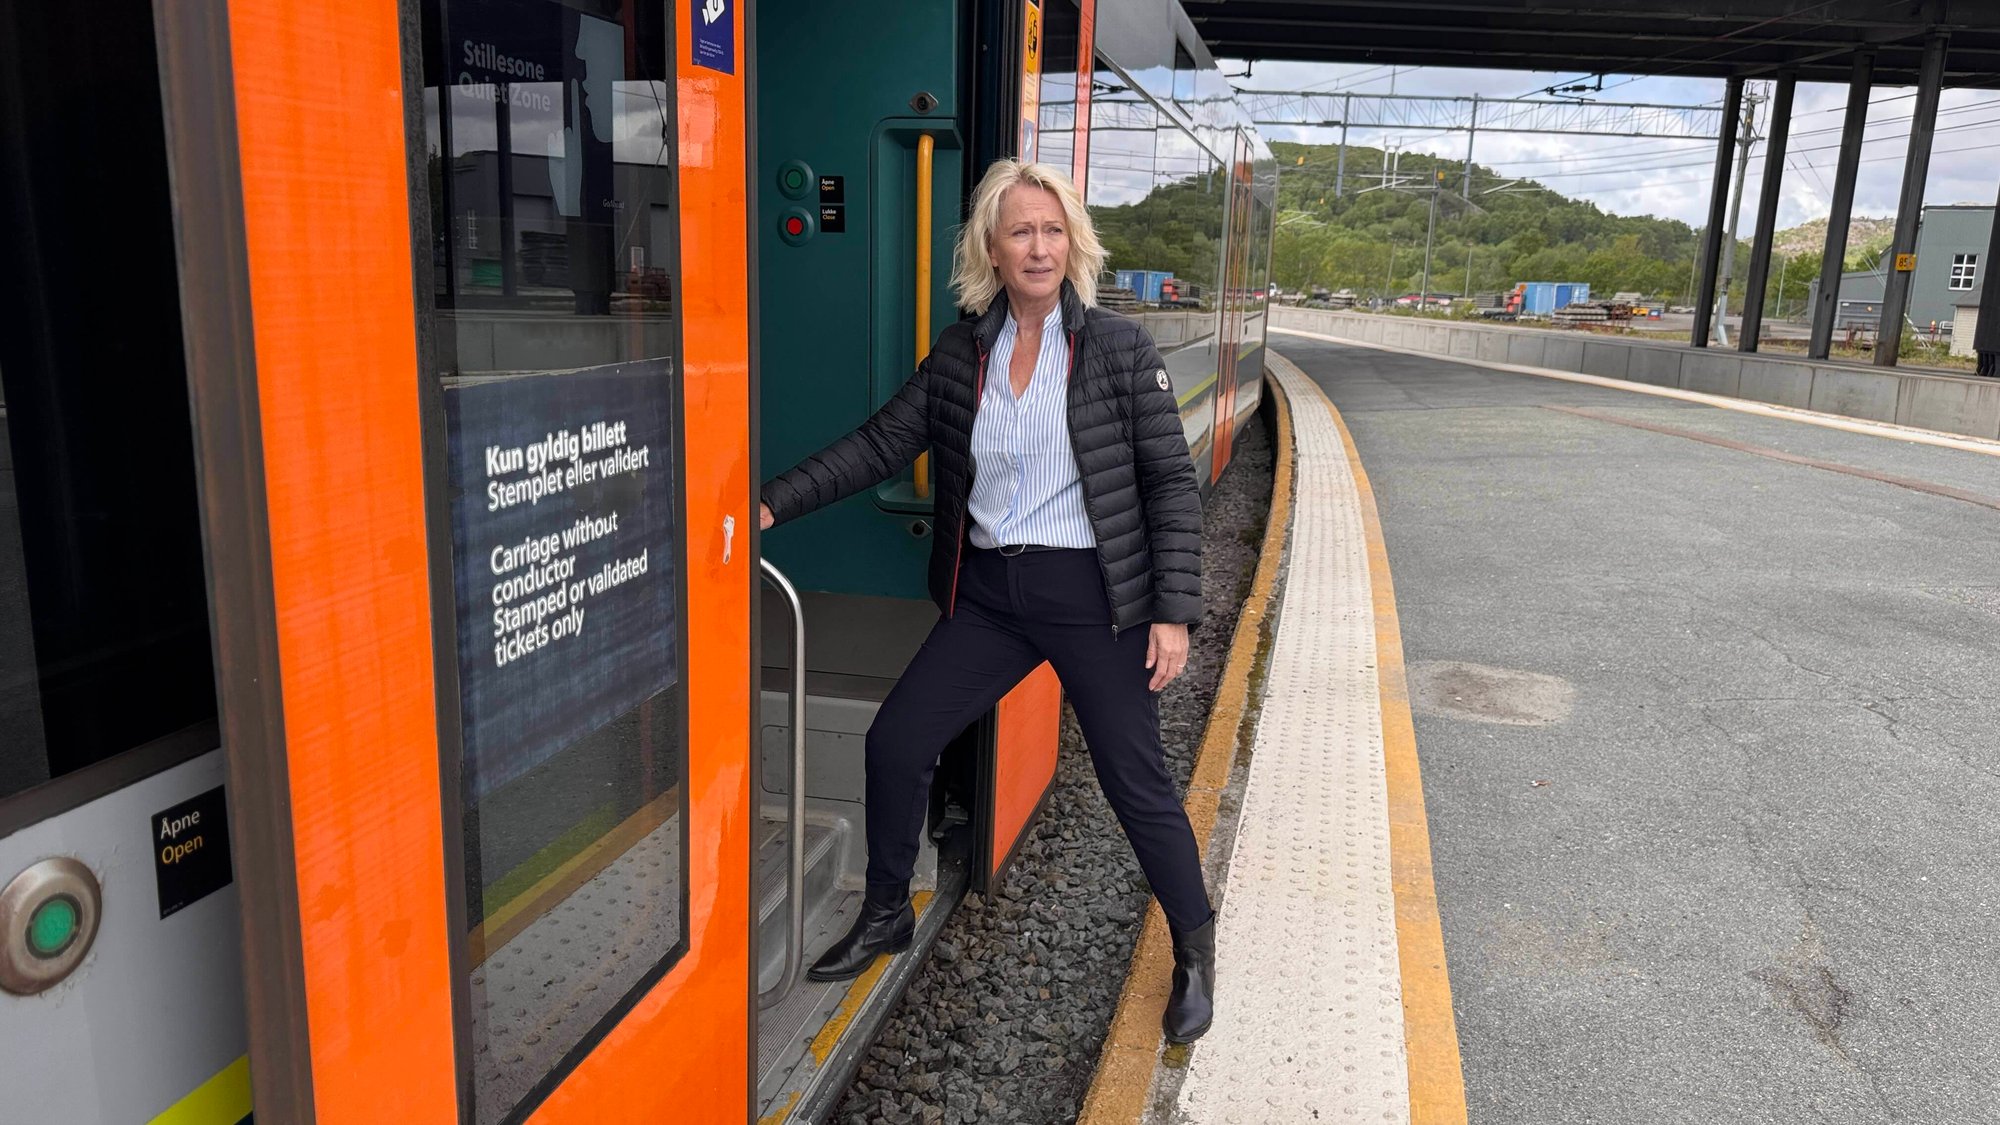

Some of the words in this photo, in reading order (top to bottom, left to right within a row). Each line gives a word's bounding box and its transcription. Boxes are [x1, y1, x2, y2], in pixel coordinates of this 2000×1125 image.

[463, 39, 545, 81] Stillesone
[458, 71, 508, 104] Quiet
[510, 84, 551, 112] Zone
[485, 445, 523, 477] Kun
[526, 432, 579, 473] gyldig
[581, 420, 627, 453] billett
[487, 466, 563, 511] Stemplet
[565, 457, 597, 490] eller
[599, 445, 649, 478] validert
[490, 533, 560, 576] Carriage
[562, 510, 618, 550] without
[492, 554, 576, 607] conductor
[493, 583, 567, 638] Stamped
[569, 578, 585, 604] or
[587, 547, 648, 598] validated
[494, 623, 550, 668] tickets
[551, 606, 585, 641] only
[160, 810, 201, 840] Åpne
[162, 835, 203, 864] Open
